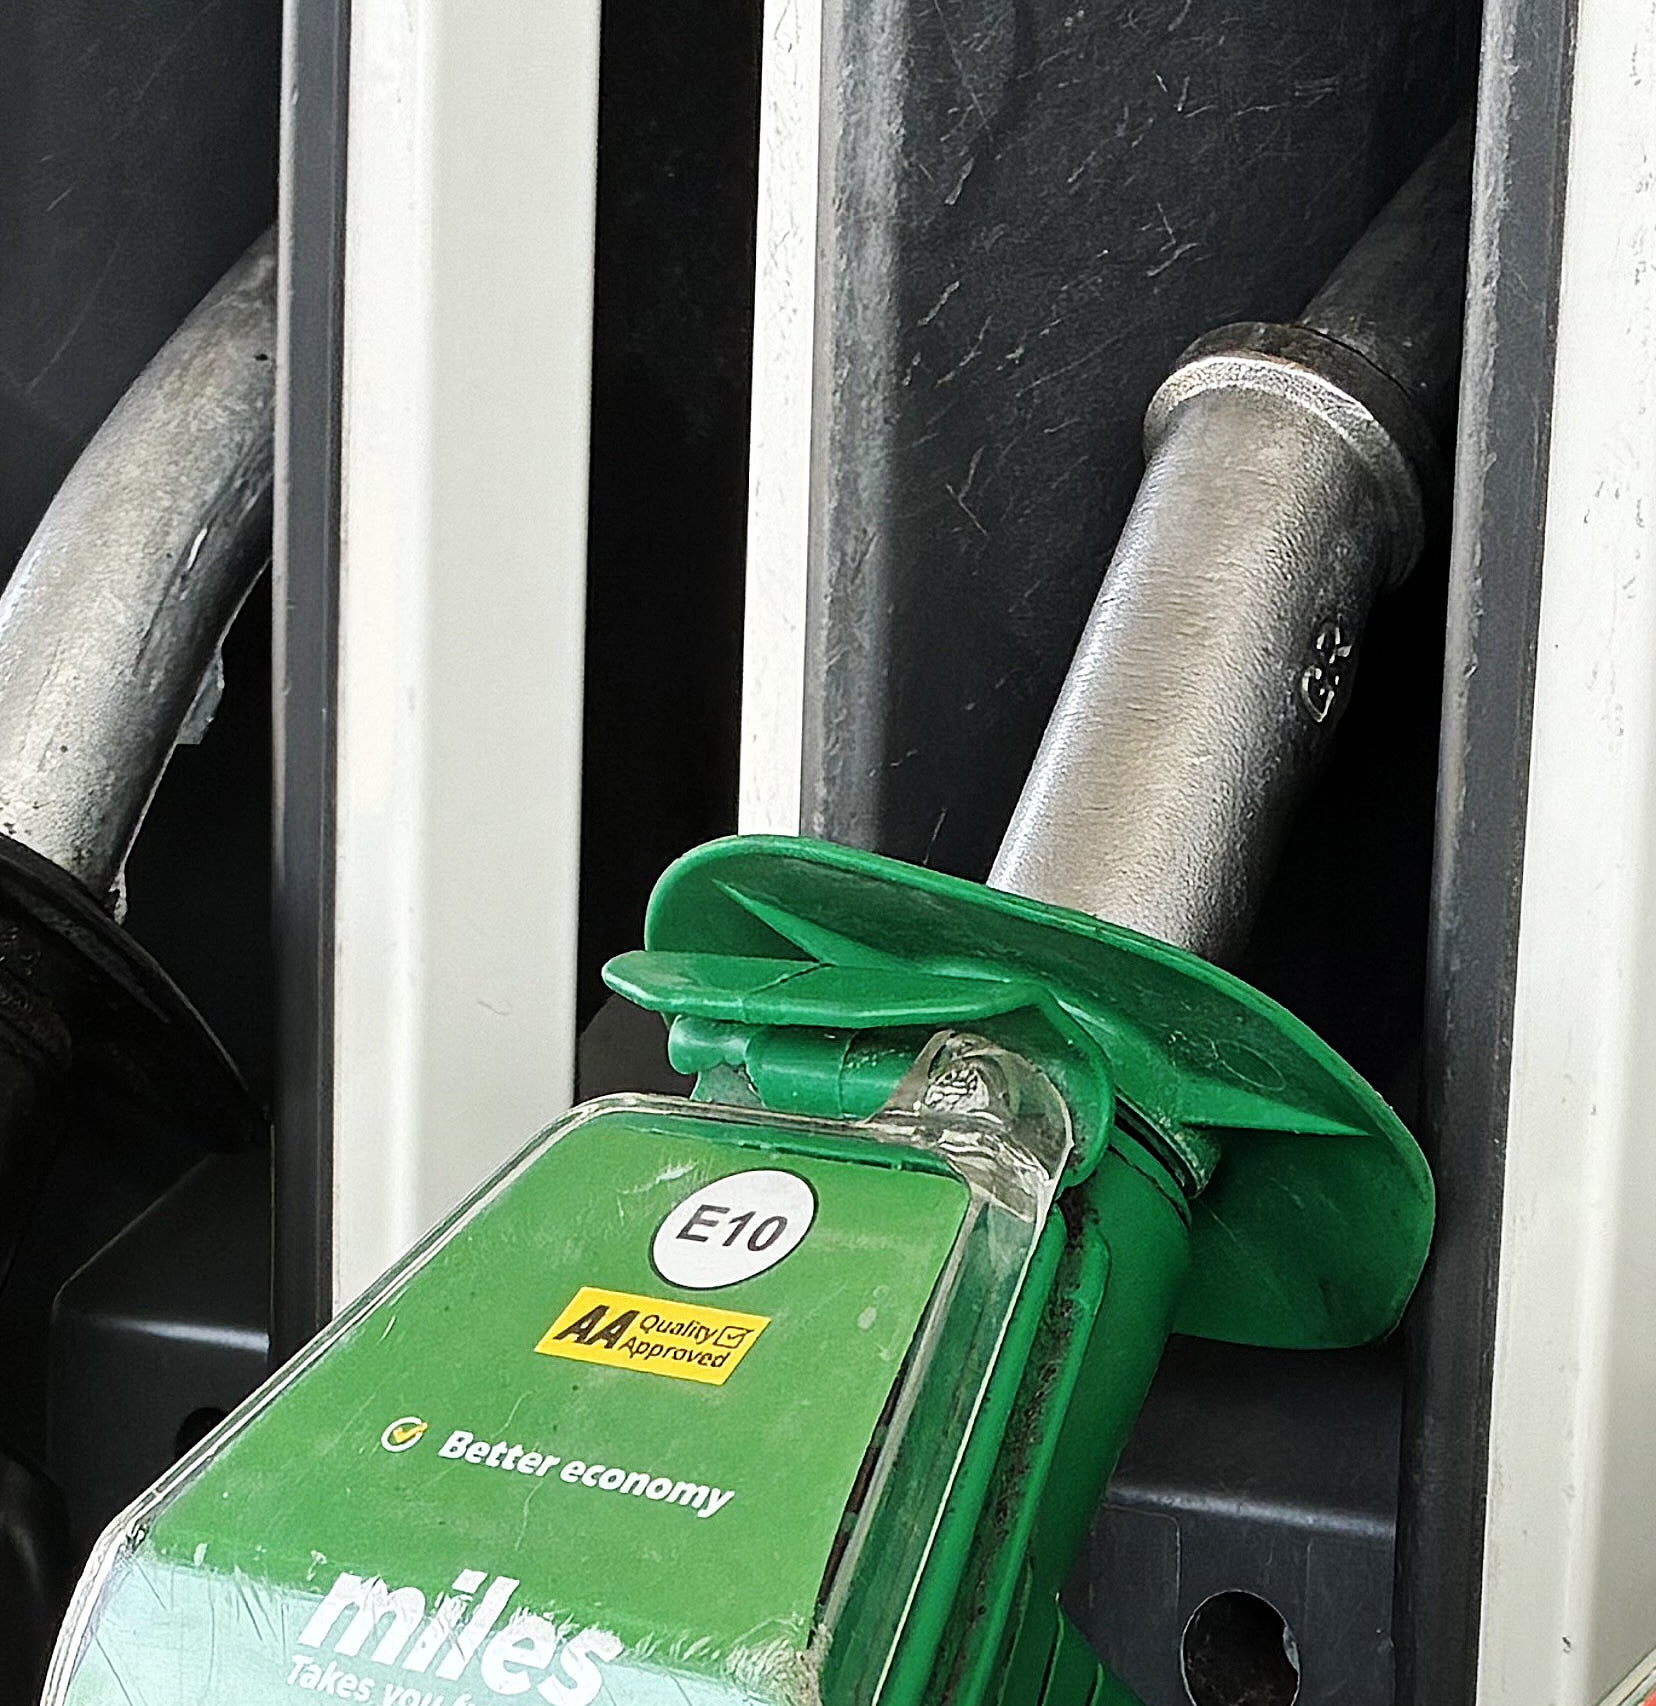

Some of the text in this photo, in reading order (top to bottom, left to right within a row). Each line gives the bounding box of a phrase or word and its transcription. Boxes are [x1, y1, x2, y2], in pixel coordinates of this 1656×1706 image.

[675, 1204, 789, 1254] E10
[552, 1304, 721, 1350] AA Quality
[618, 1336, 731, 1368] Approved
[439, 1429, 737, 1518] Better economy
[285, 1654, 376, 1702] Takes
